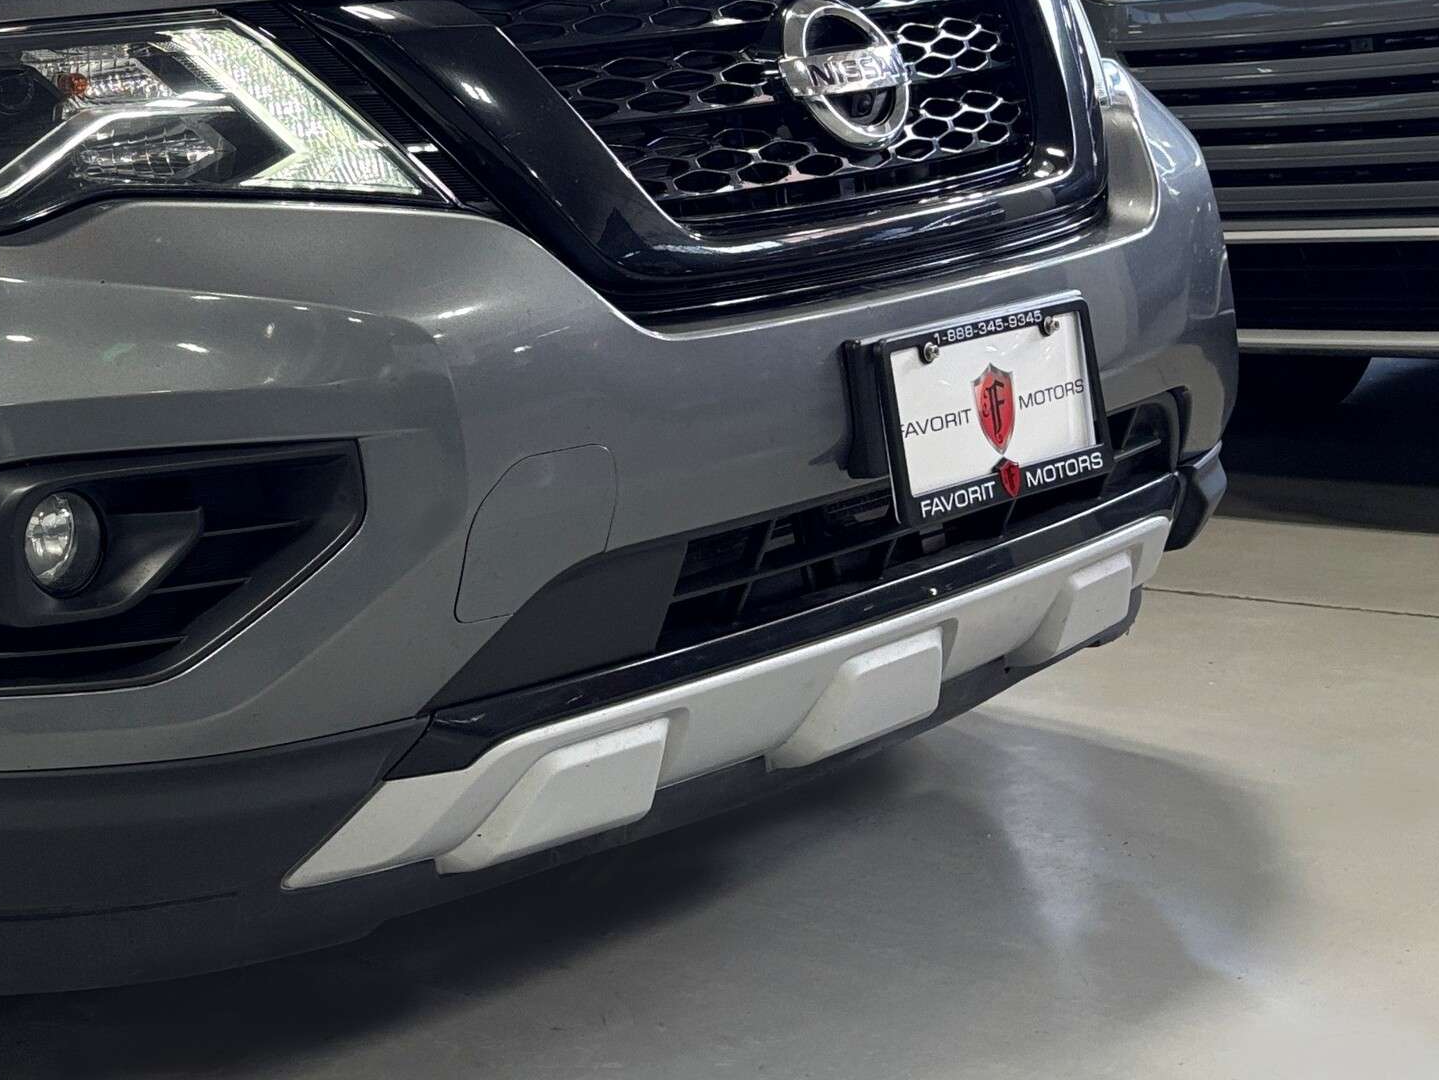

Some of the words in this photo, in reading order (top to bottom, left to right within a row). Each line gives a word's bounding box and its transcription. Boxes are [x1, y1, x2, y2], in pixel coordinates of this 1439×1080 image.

[933, 310, 1043, 346] 1-888-345-9345
[1018, 378, 1085, 410] MOTORS
[920, 481, 996, 519] FAVORIT
[1025, 451, 1104, 488] MOTORS
